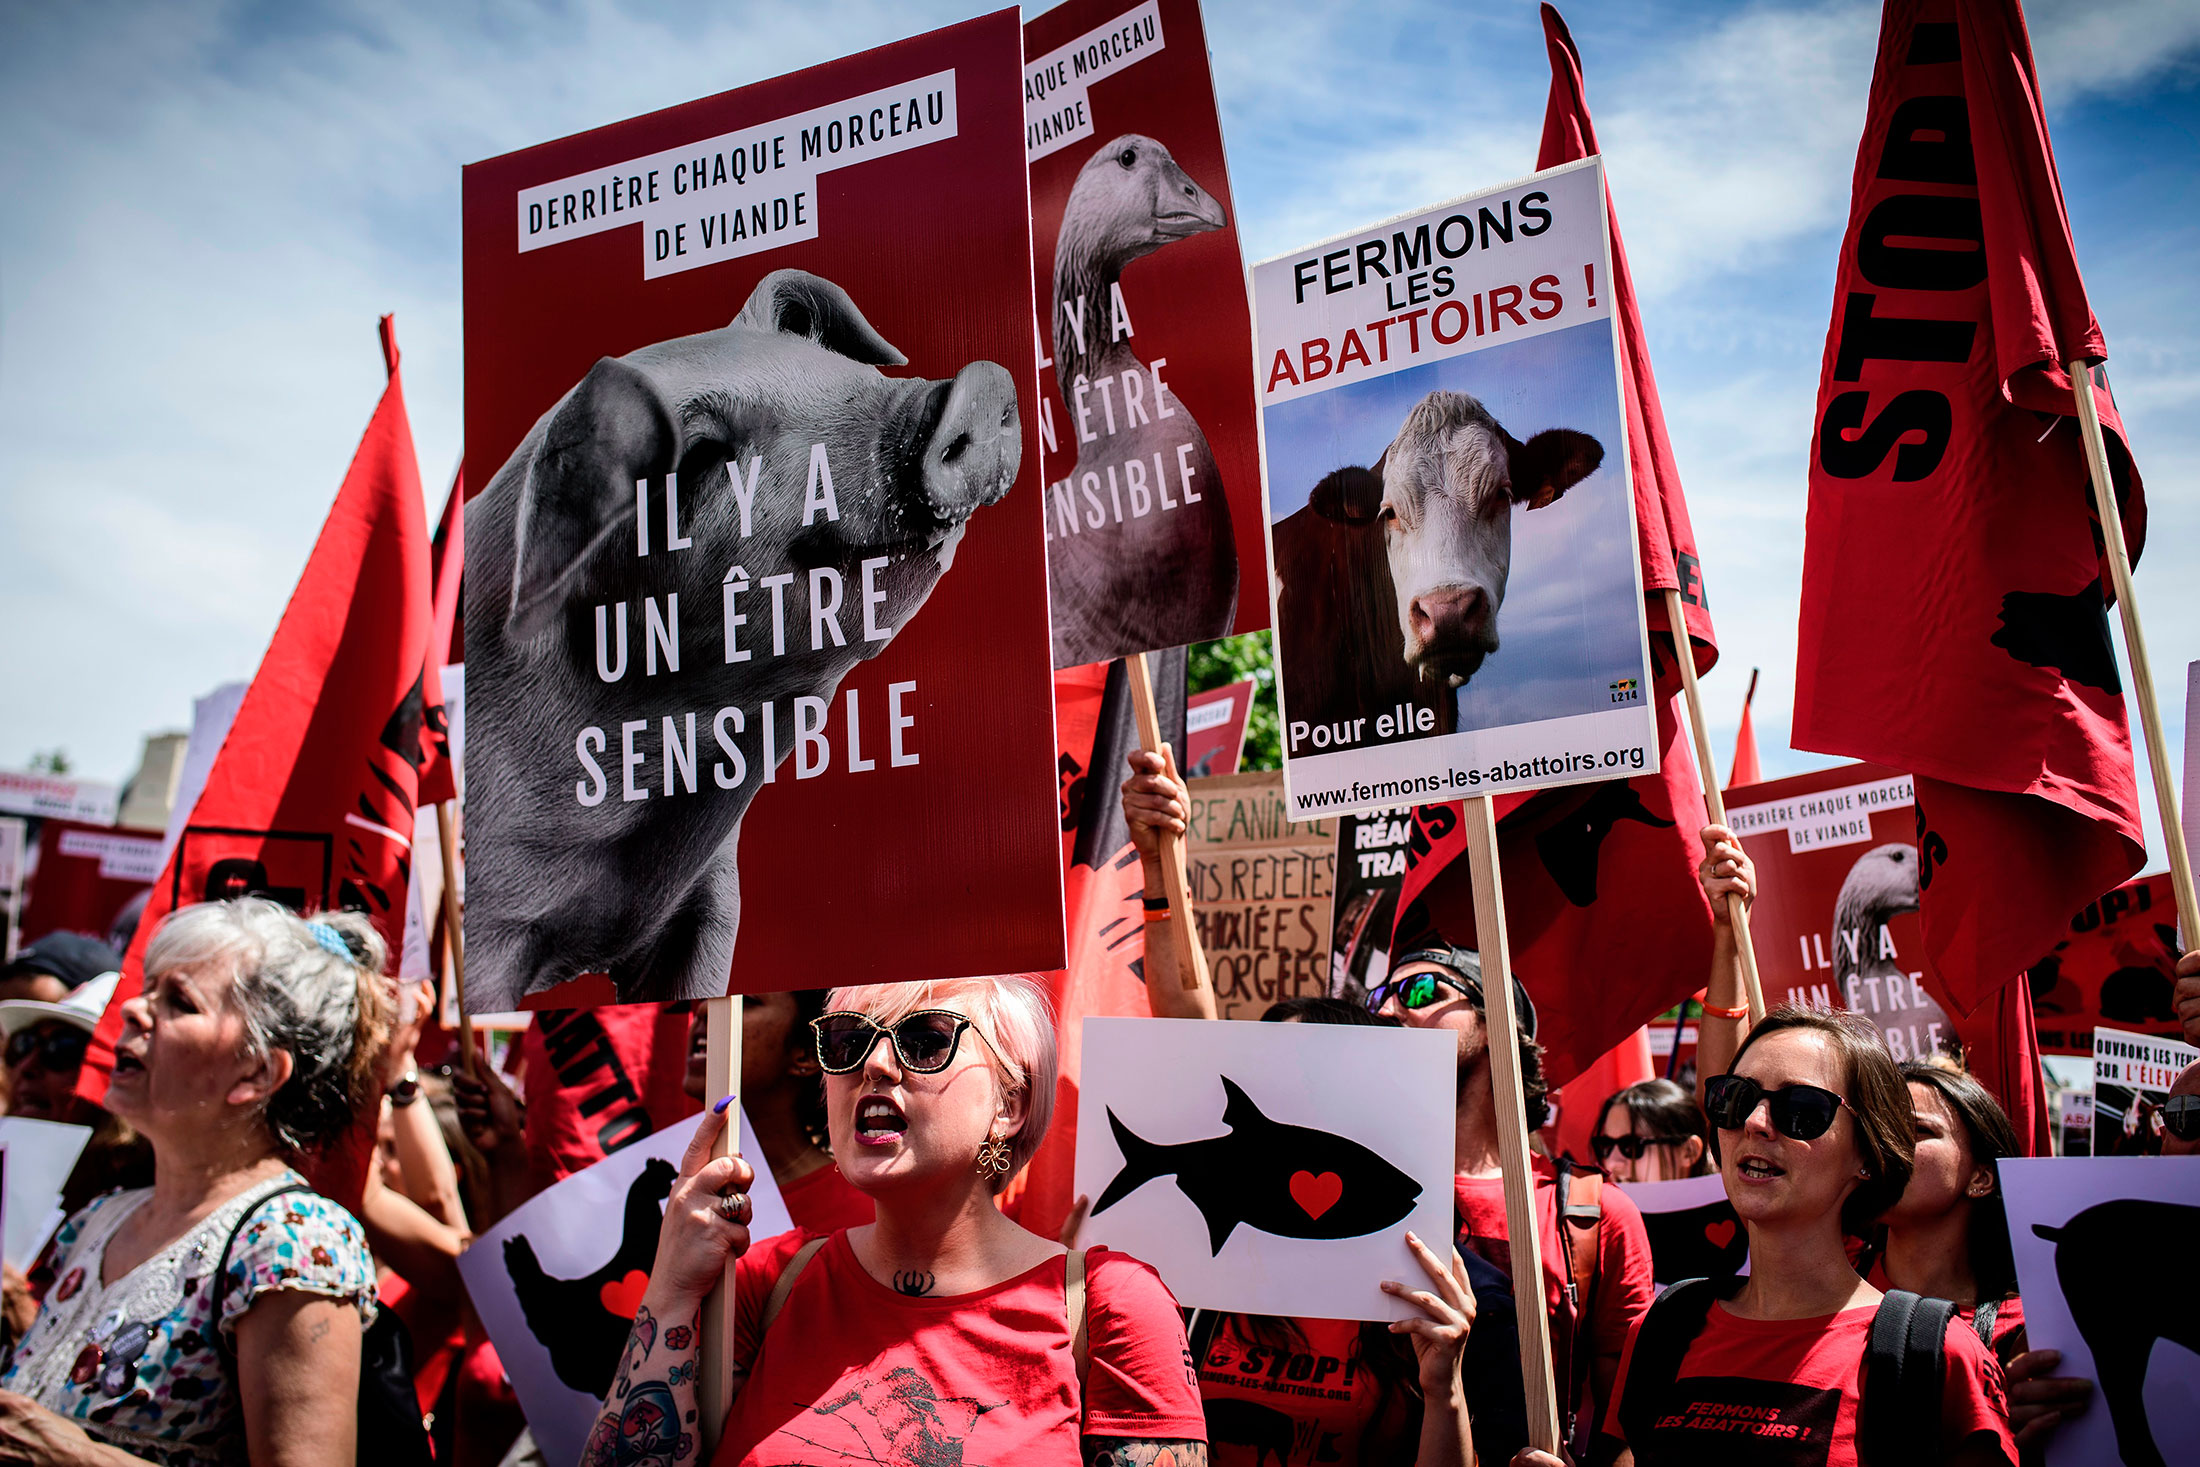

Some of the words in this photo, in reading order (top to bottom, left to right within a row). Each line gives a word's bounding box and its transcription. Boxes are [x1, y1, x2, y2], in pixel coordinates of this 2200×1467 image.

[1073, 15, 1155, 78] MORCEAU
[529, 169, 660, 236] DERRIÈRE
[673, 135, 786, 196] CHAQUE
[801, 90, 944, 162] MORCEAU
[655, 223, 687, 262] DE
[700, 191, 807, 249] VIANDE
[1293, 190, 1553, 305] FERMONS
[1063, 295, 1086, 355] Y
[1110, 281, 1135, 343] A
[1386, 265, 1456, 312] LES
[1266, 274, 1564, 394] ABATTOIRS
[1073, 357, 1175, 444] ÊTRE
[636, 472, 692, 557] IL
[726, 455, 763, 538] Y
[802, 443, 840, 526] A
[1047, 443, 1202, 541] NSIBLE
[595, 592, 680, 683] UN
[722, 555, 892, 664] ÊTRE
[1289, 715, 1366, 752] Pour
[1375, 702, 1436, 739] elle
[1611, 690, 1638, 703] L214
[575, 680, 920, 807] SENSIBLE
[1296, 745, 1645, 810] www.fermons-les-abattoirs.org
[1732, 805, 1795, 831] DERRIÈRE
[1800, 797, 1851, 819] CHAQUE
[1795, 829, 1810, 845] DE
[1816, 819, 1865, 842] VIANDE
[1800, 933, 1831, 971] IL
[1841, 928, 1860, 964] Y
[1879, 923, 1898, 960] A
[1846, 971, 1928, 1015] ÊTRE
[2096, 1062, 2119, 1078] SUR
[2097, 1039, 2150, 1061] OUVRONS
[2154, 1048, 2170, 1064] LES
[1654, 1415, 1684, 1429] LES
[1685, 1417, 1799, 1439] ABATTOIRS
[1685, 1402, 1780, 1421] FERMONS
